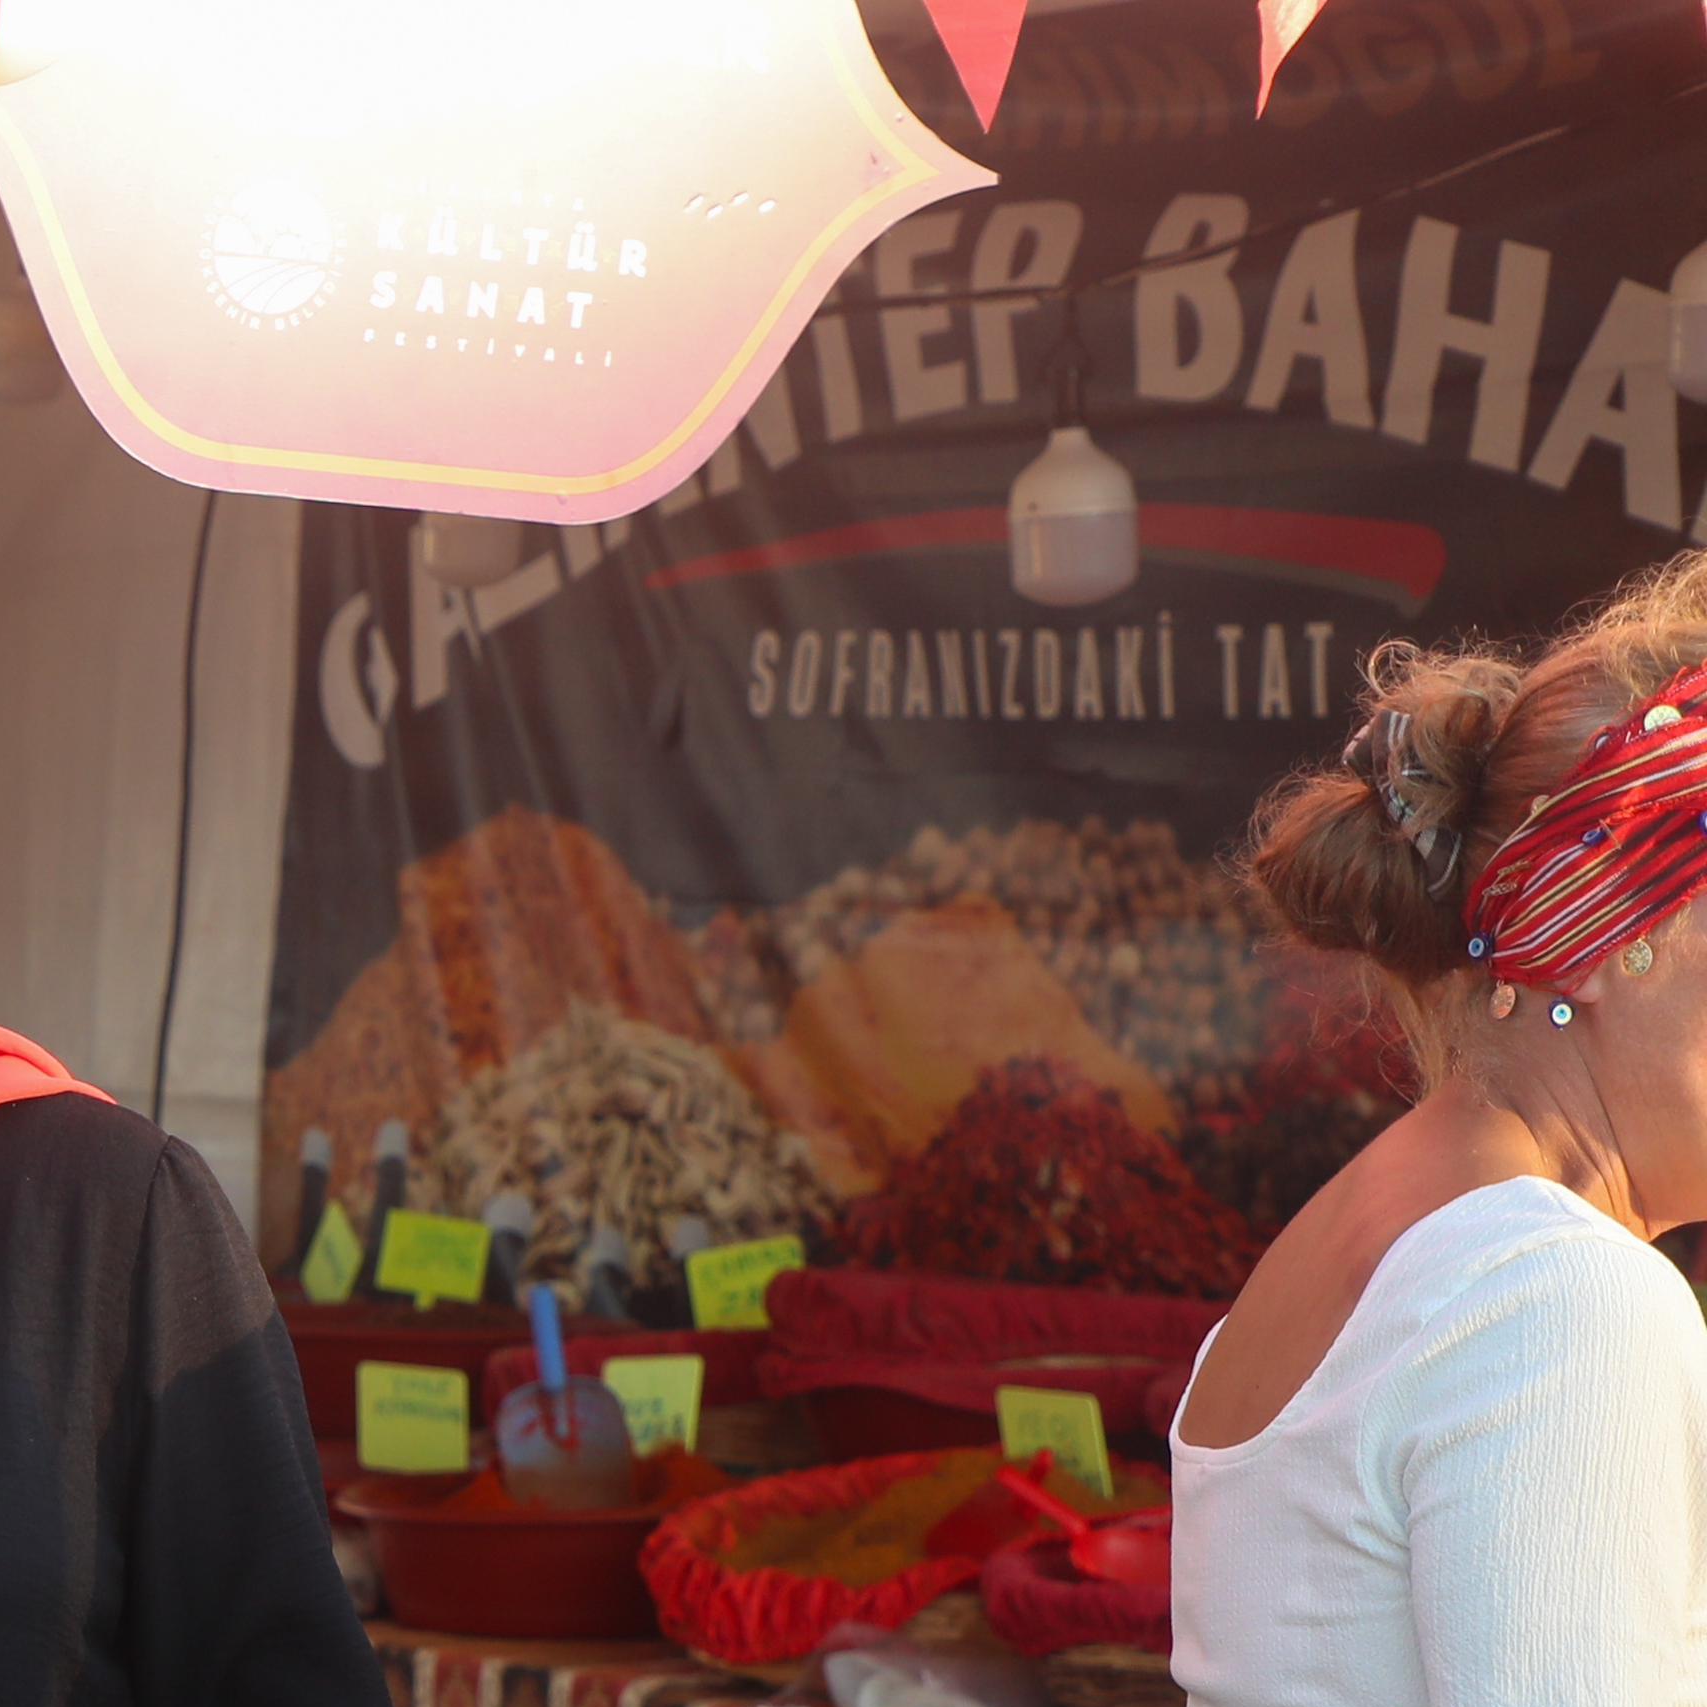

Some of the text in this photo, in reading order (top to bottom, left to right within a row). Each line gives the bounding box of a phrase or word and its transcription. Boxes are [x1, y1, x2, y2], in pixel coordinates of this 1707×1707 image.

[376, 205, 648, 279] KÜLTÜR
[368, 269, 593, 329] SANAT
[1135, 193, 1707, 548] BAHA
[748, 611, 1335, 721] SOFRANIZDAKİ TAT
